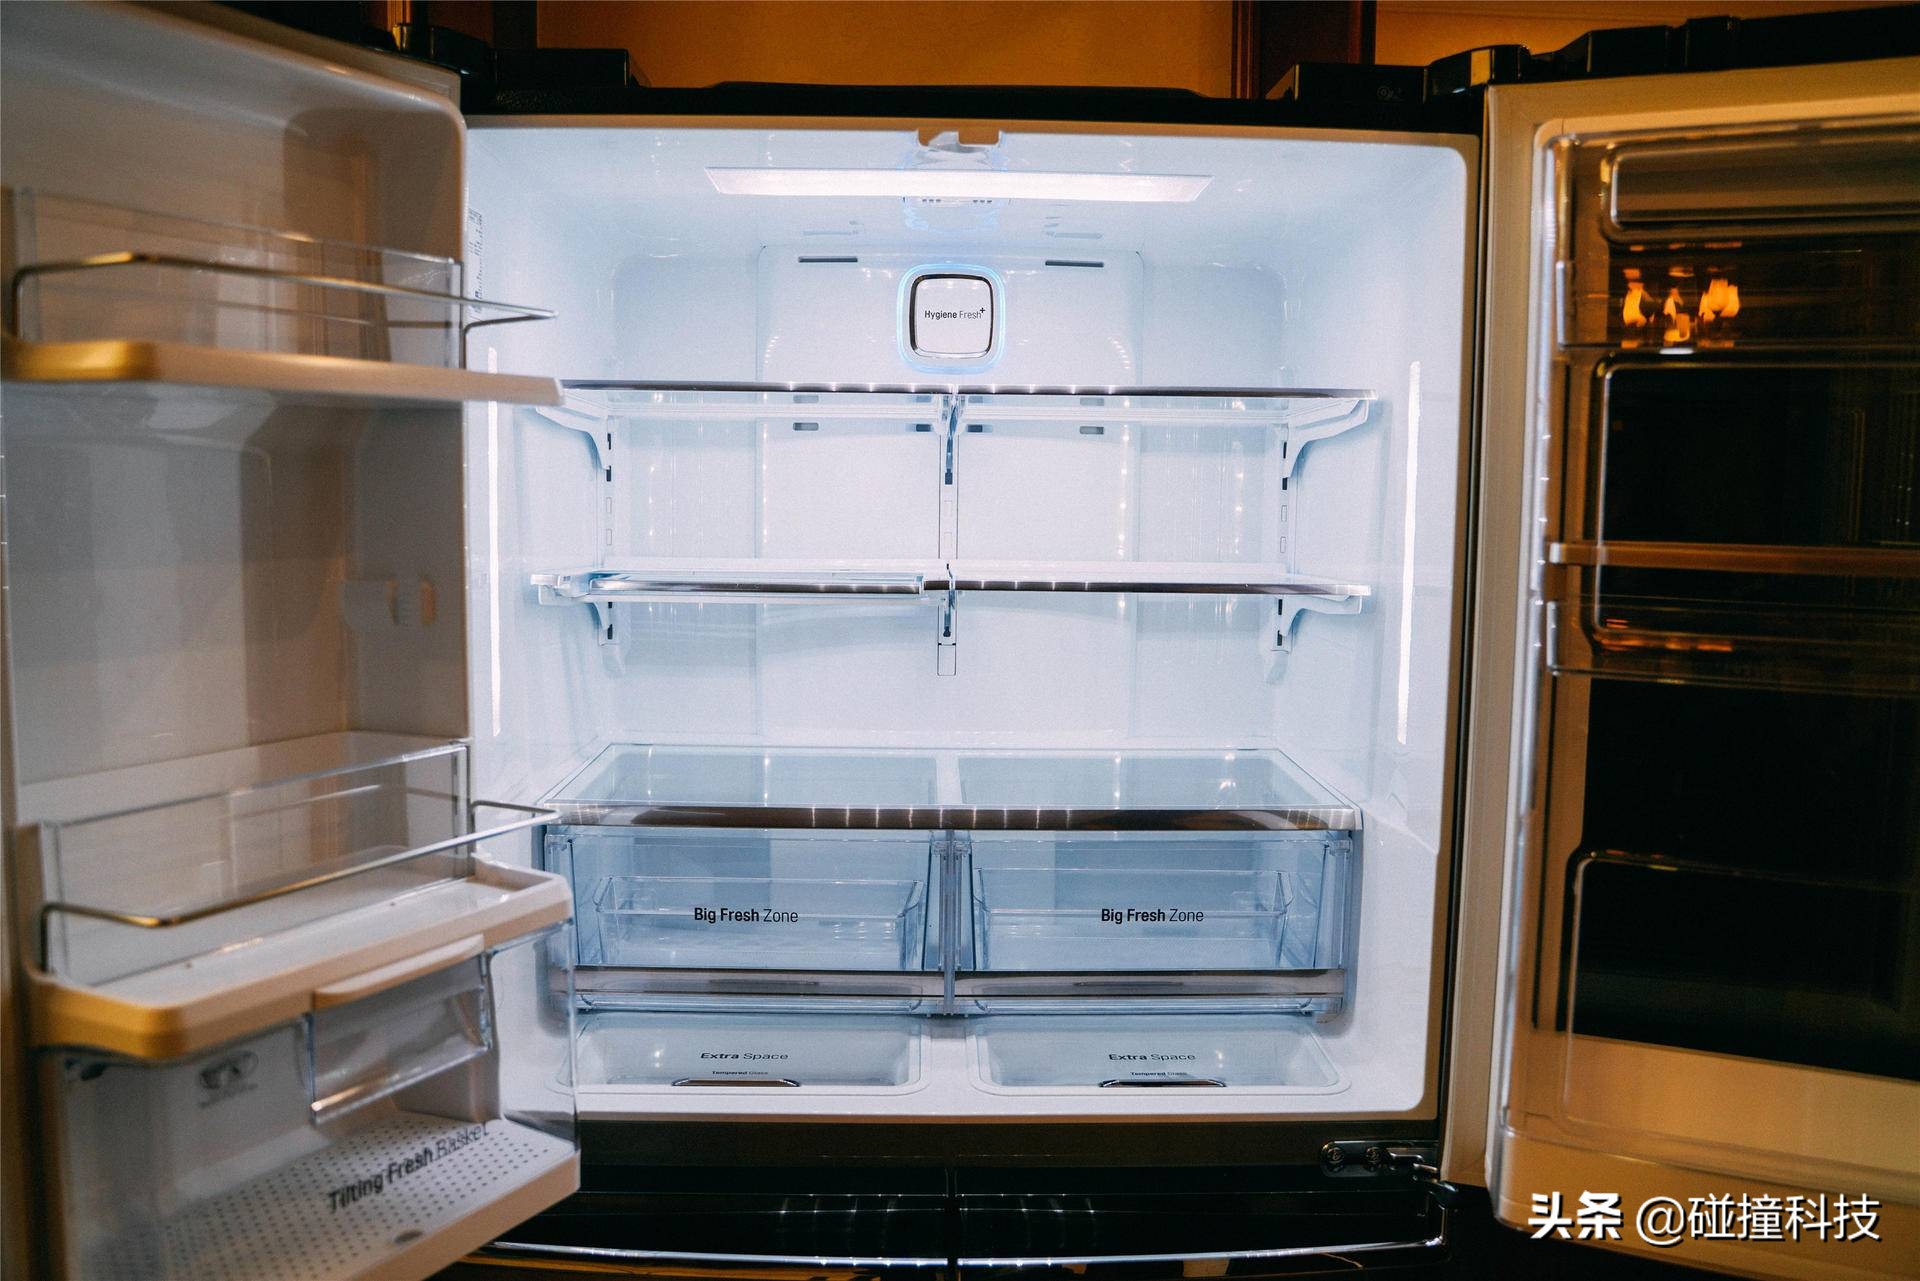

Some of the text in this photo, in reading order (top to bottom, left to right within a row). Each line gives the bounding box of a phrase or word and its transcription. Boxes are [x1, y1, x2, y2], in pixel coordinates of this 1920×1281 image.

[924, 310, 957, 320] Hygiene
[694, 907, 799, 923] Big Fresh Zone
[1101, 908, 1205, 924] Big Fresh Zone
[700, 1052, 789, 1061] Extra Space
[1108, 1053, 1196, 1061] Extra Space
[328, 1174, 384, 1214] Tilting
[387, 1148, 433, 1184] Fresh
